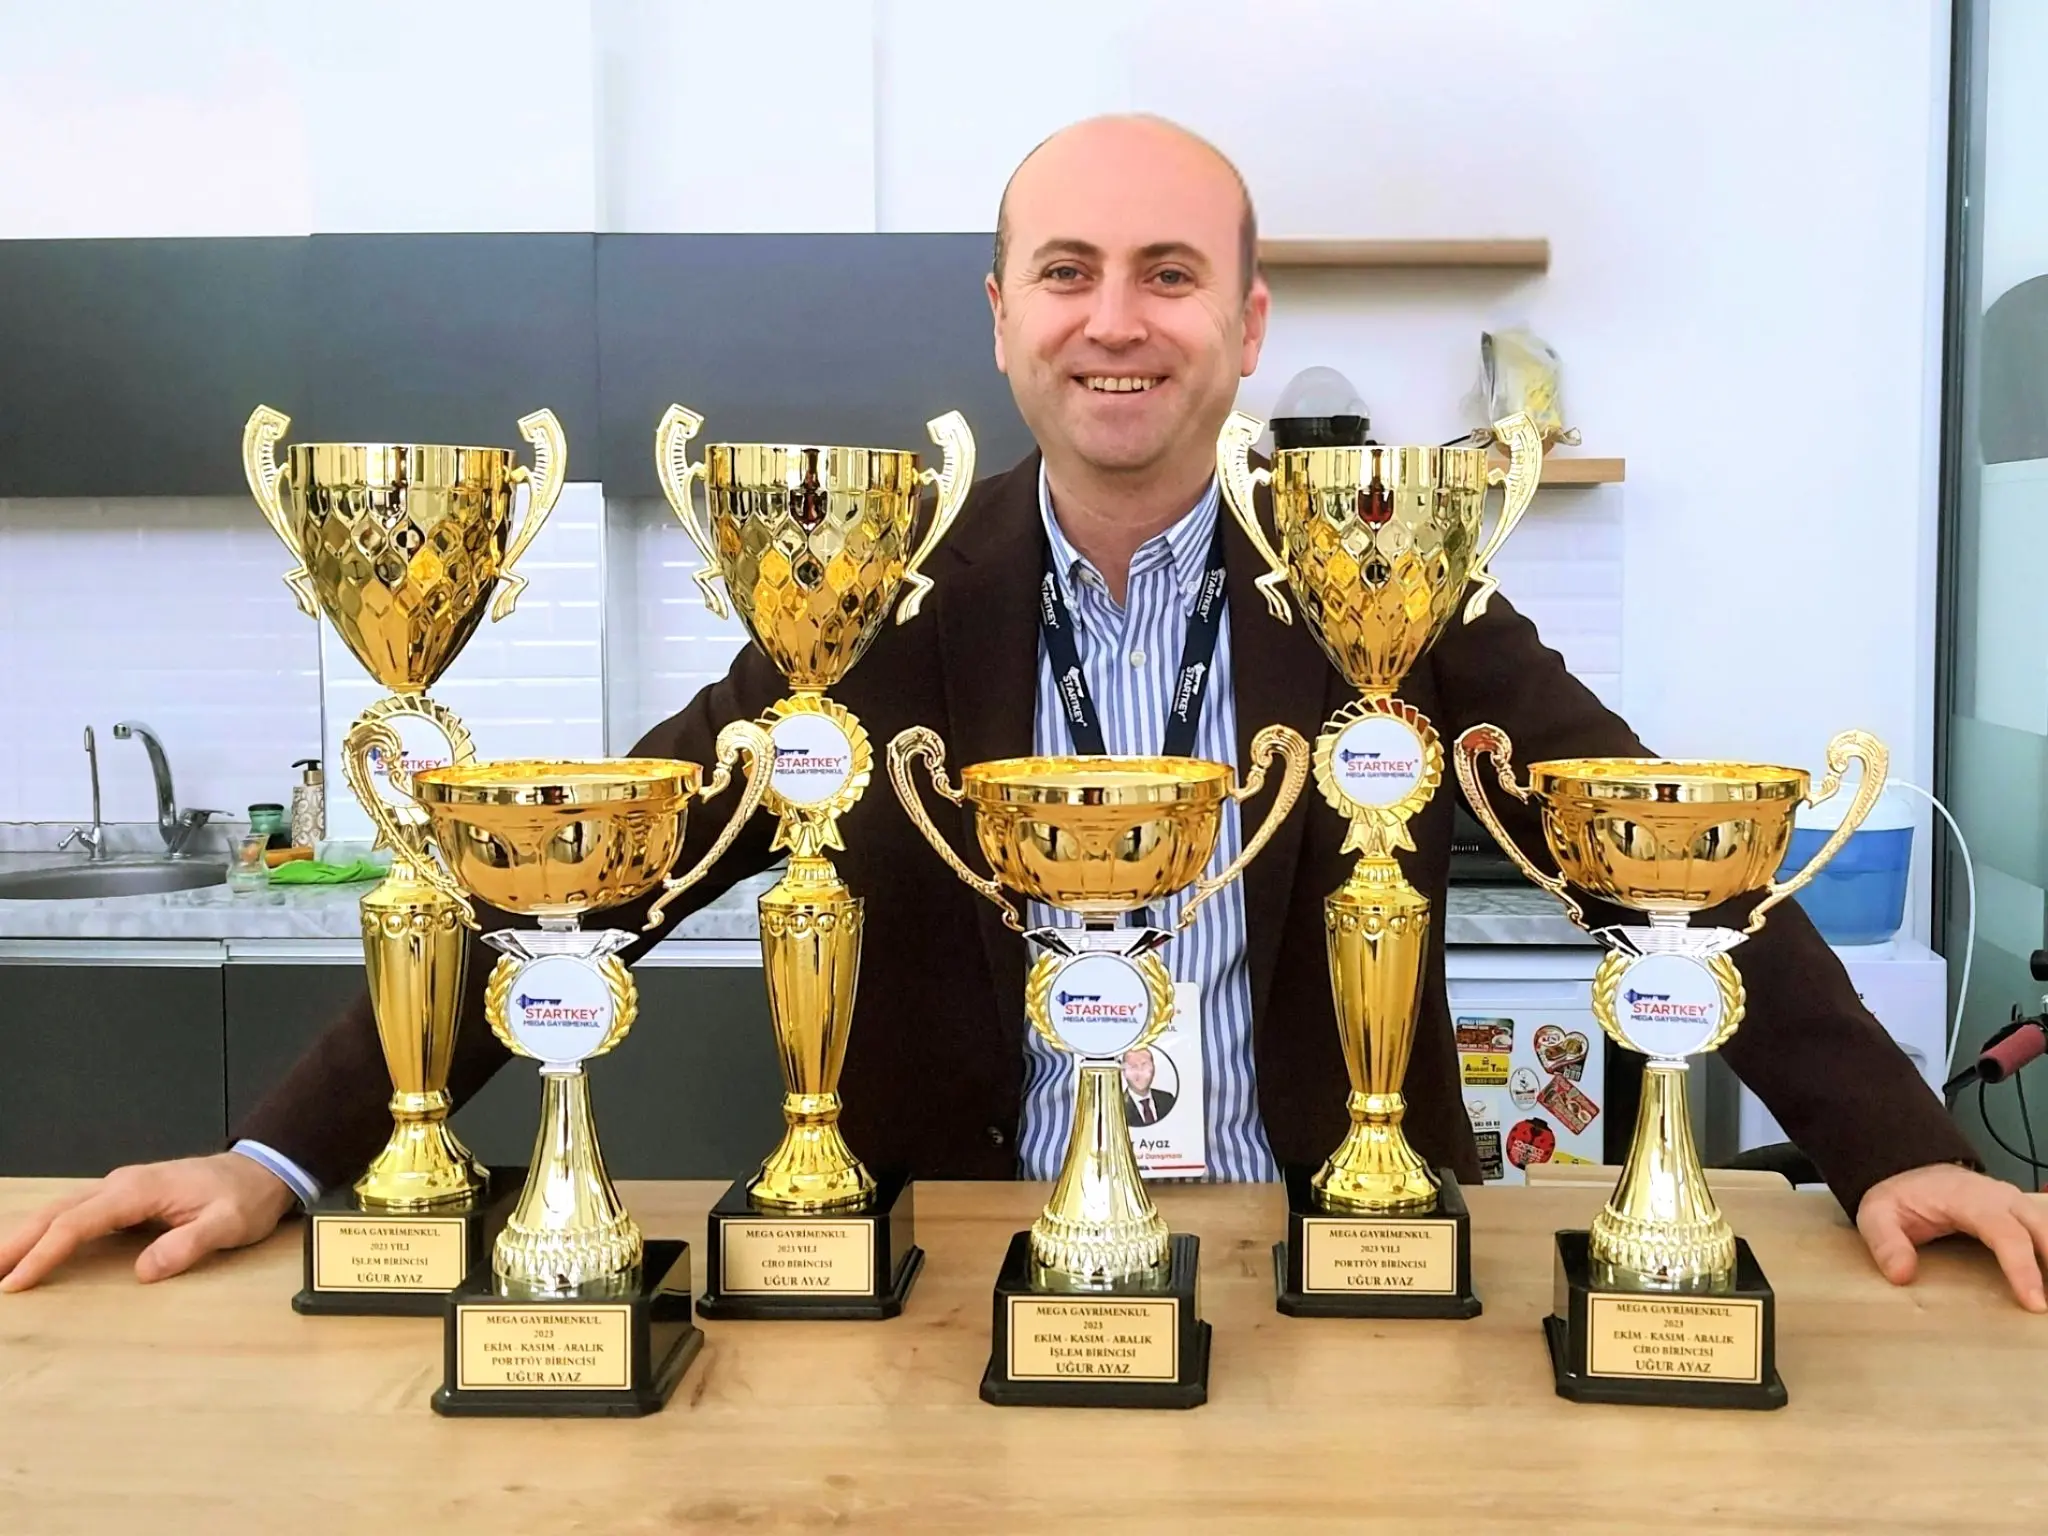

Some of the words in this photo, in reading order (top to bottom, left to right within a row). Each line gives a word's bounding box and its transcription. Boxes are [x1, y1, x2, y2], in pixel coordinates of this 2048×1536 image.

[376, 759, 442, 770] SRTKEY
[1140, 1138, 1170, 1150] Ayaz
[339, 1227, 367, 1236] MEGA
[369, 1227, 441, 1237] GAYRİMENKUL
[746, 1230, 774, 1238] MEGA
[776, 1229, 848, 1238] GAYRİMENKUL
[1329, 1229, 1357, 1238] MEGA
[1360, 1230, 1432, 1239] GAYRİMENKUL
[1334, 1258, 1379, 1268] PORTFÖY
[357, 1272, 391, 1283] UĞUR
[394, 1274, 424, 1284] AYAZ
[764, 1276, 798, 1286] UĞUR
[800, 1277, 831, 1286] AYAZ
[1347, 1274, 1381, 1285] UĞUR
[1384, 1277, 1414, 1286] AYAZ
[1036, 1306, 1068, 1316] MEGA
[1070, 1306, 1151, 1317] GAYRİMENKUL
[1616, 1303, 1648, 1313] MEGA
[1650, 1305, 1732, 1317] GAYRİMENKUL
[486, 1315, 518, 1324] MEGA
[520, 1315, 602, 1325] GAYRİMENKUL
[1083, 1321, 1103, 1330] 2023
[533, 1330, 554, 1338] 2023
[1034, 1333, 1062, 1343] EKİM
[1070, 1335, 1104, 1344] KASIM
[1112, 1335, 1153, 1344] ARALIK
[1613, 1330, 1642, 1340] EKİM
[1650, 1332, 1685, 1342] KASIM
[1694, 1333, 1735, 1344] ARALIK
[484, 1342, 512, 1352] EKİM
[521, 1343, 554, 1352] KASIM
[564, 1343, 604, 1352] ARALIK
[1050, 1347, 1083, 1358] İŞLEM
[1633, 1344, 1660, 1354] CİRO
[492, 1355, 543, 1365] PORTFÖY
[1635, 1358, 1674, 1372] UĞUR
[1677, 1362, 1712, 1373] AYAZ
[1056, 1362, 1094, 1373] UĞUR
[1097, 1363, 1131, 1374] AYAZ
[506, 1371, 545, 1382] UĞUR
[548, 1372, 582, 1382] AYAZ
